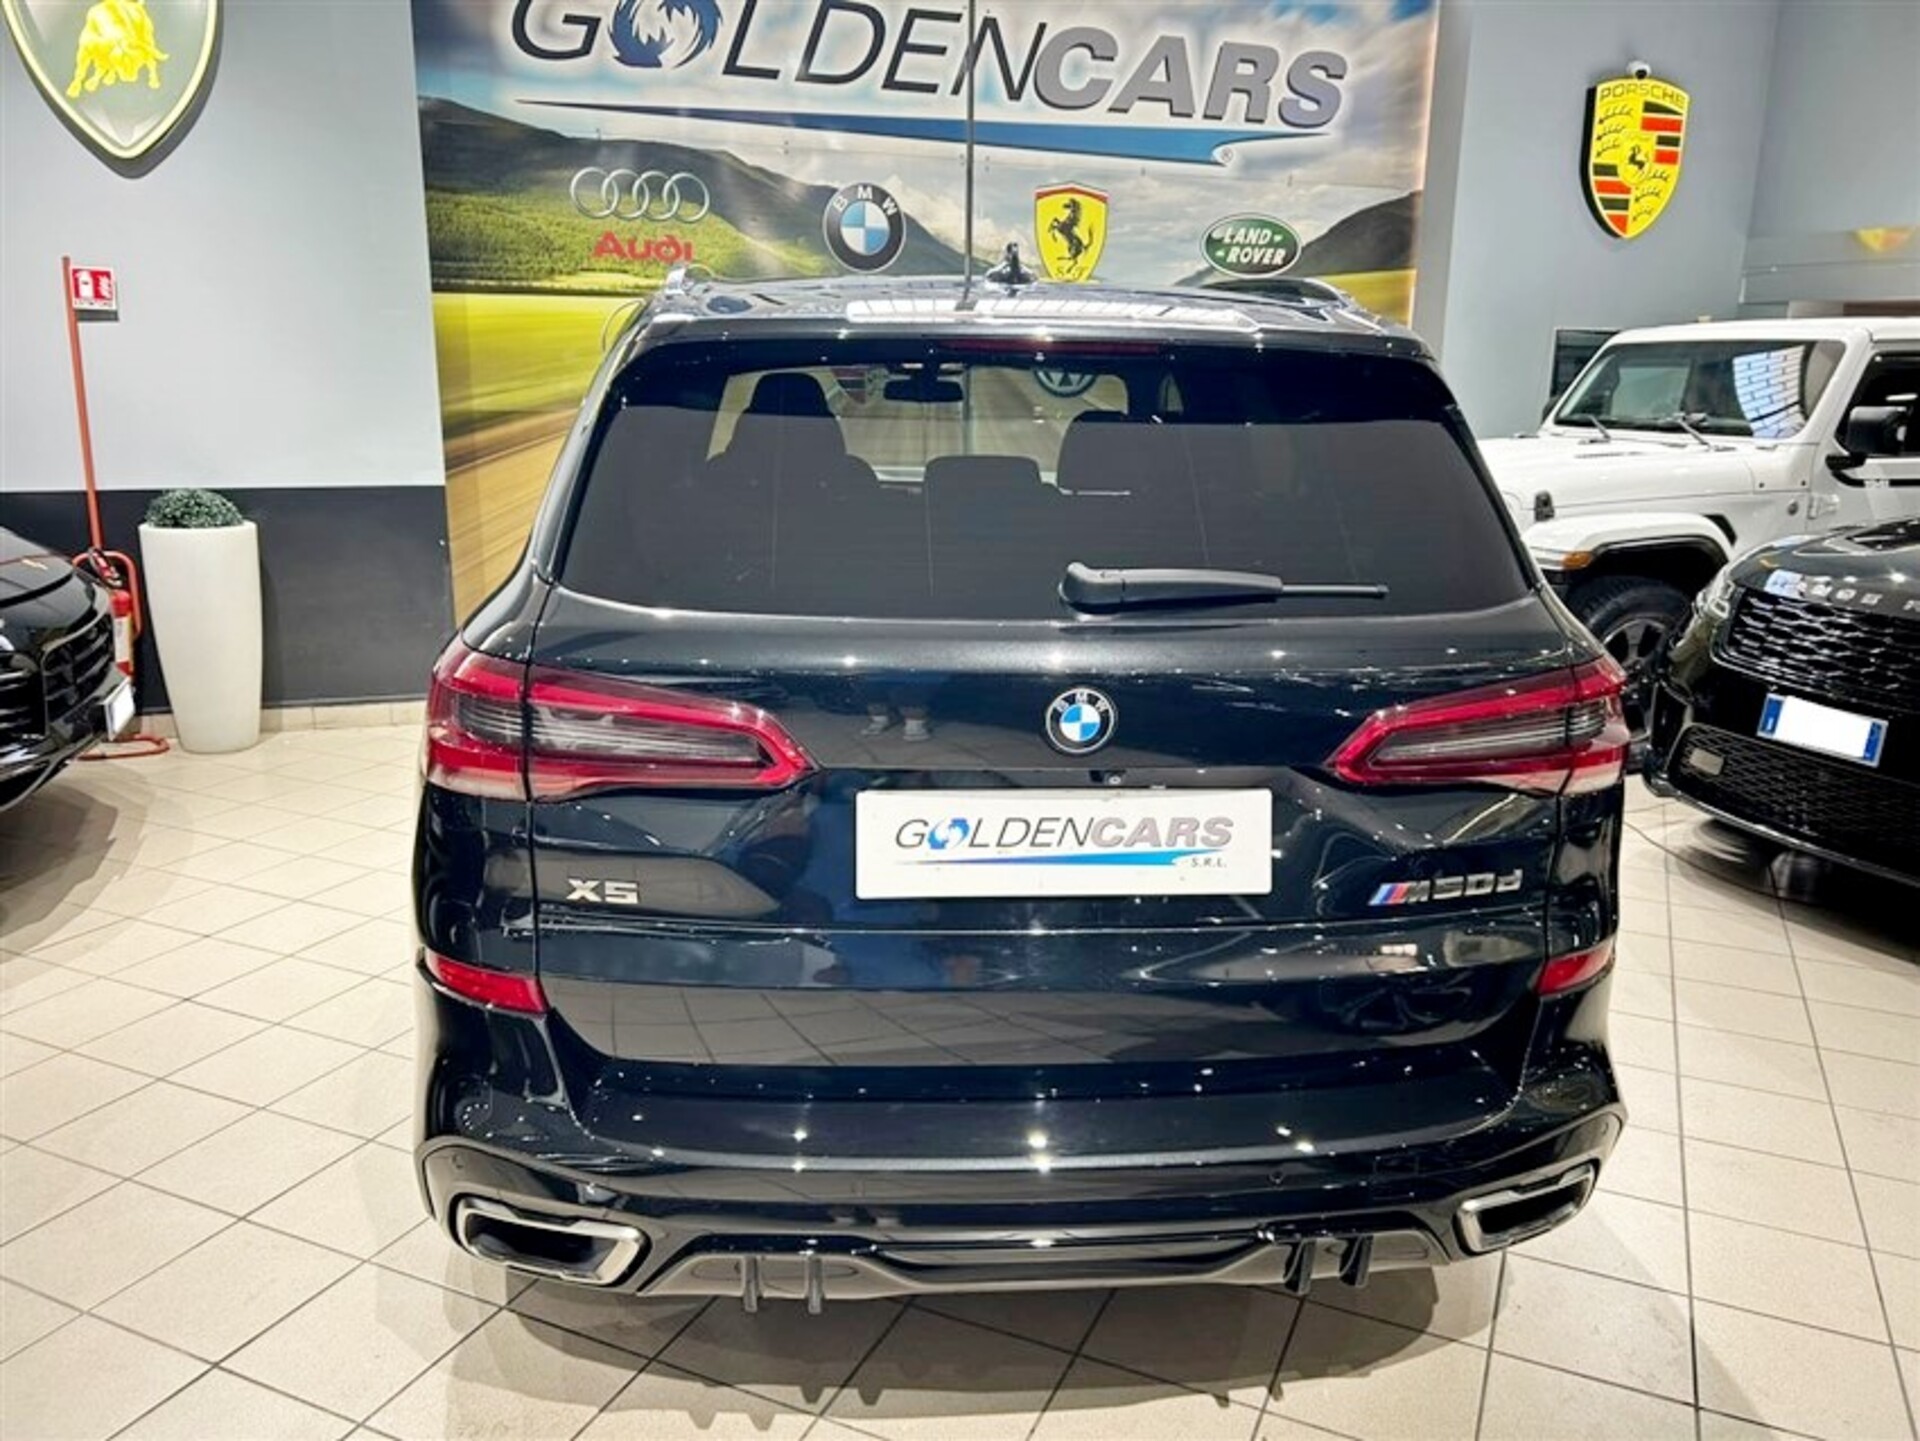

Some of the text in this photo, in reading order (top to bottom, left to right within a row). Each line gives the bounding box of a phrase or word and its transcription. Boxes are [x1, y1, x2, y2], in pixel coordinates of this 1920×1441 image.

[1600, 83, 1687, 109] PORSCHE
[832, 185, 898, 216] BMW
[593, 229, 694, 265] Audi
[1222, 227, 1273, 245] LAND
[1226, 246, 1287, 265] ROVER
[1054, 690, 1109, 712] BMW
[566, 878, 639, 904] X5
